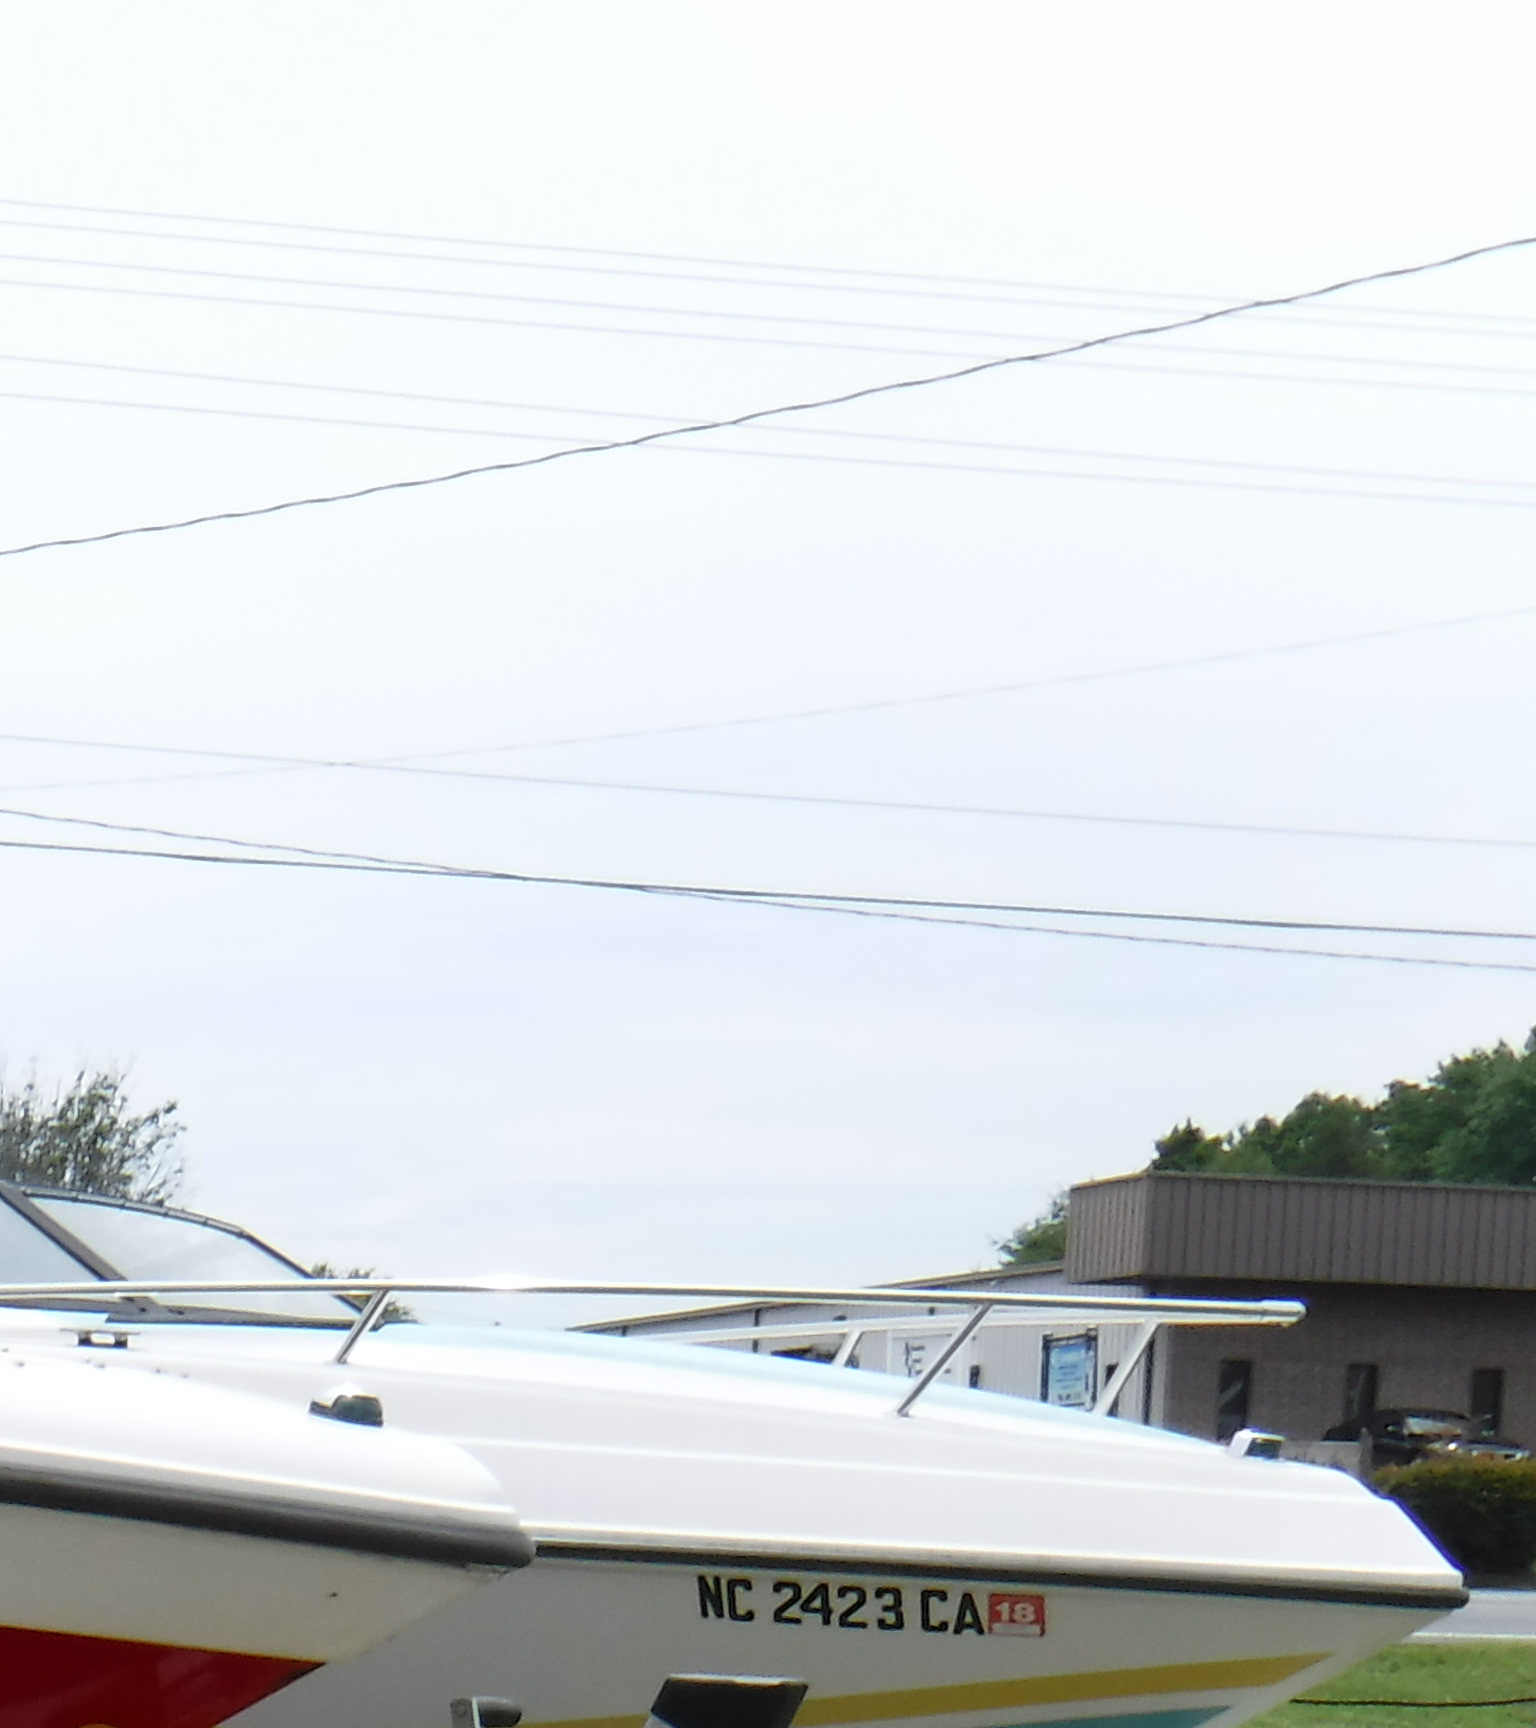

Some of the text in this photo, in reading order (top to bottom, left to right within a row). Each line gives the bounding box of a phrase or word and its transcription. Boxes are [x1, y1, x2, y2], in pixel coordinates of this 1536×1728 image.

[697, 1574, 986, 1636] NC 2423 CA
[994, 1601, 1036, 1624] 18
